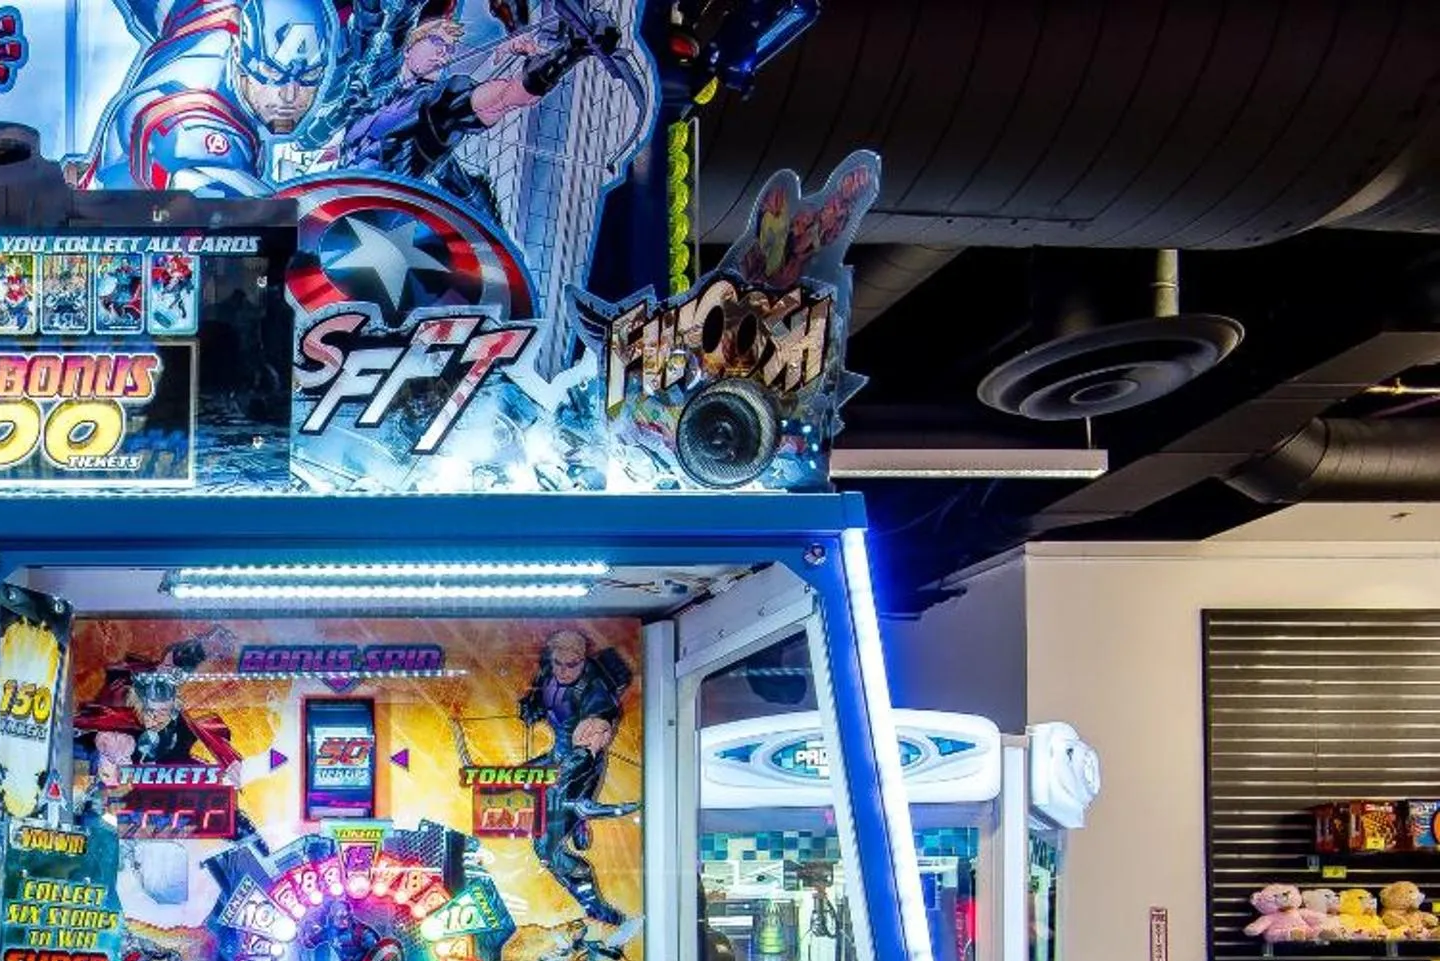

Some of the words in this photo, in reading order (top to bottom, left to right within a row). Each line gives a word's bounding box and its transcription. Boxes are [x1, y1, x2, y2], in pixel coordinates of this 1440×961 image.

[1, 236, 44, 252] YOU
[52, 236, 143, 252] COLLECT
[145, 236, 187, 252] ALL
[187, 236, 260, 252] CARDS
[67, 455, 141, 469] TICKETS
[240, 648, 354, 672] BONUS
[362, 648, 443, 672] SPIN
[0, 679, 53, 724] 150
[119, 767, 220, 784] TICKETS
[463, 768, 558, 785] TOKENS
[23, 880, 106, 905] COLLECT
[58, 930, 98, 949] WIN
